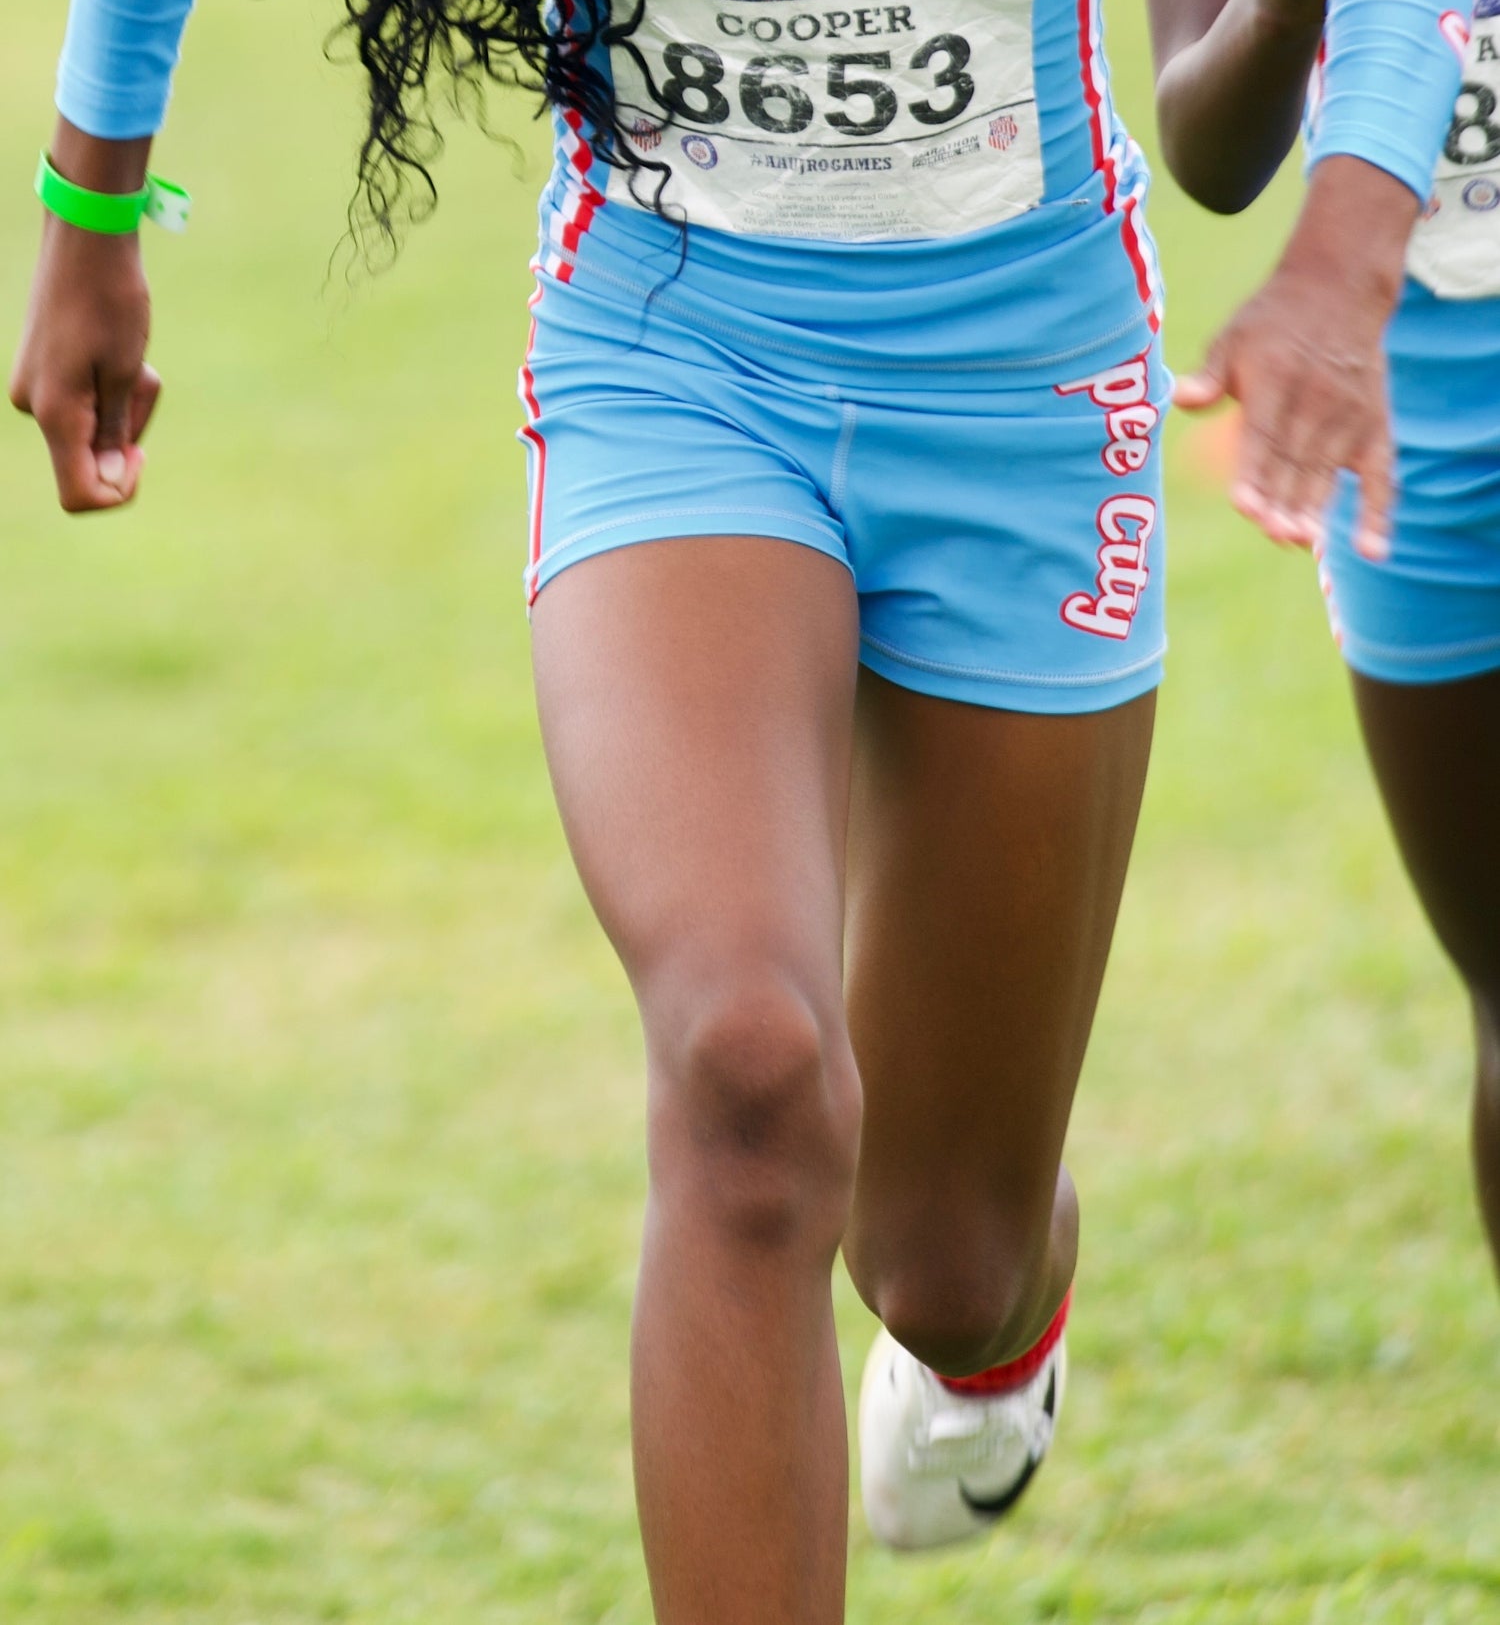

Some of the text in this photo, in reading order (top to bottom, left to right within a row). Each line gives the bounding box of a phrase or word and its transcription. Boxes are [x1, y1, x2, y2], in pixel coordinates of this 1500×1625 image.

[716, 4, 916, 43] COOPER
[662, 33, 976, 136] 8653
[1059, 493, 1158, 641] City
